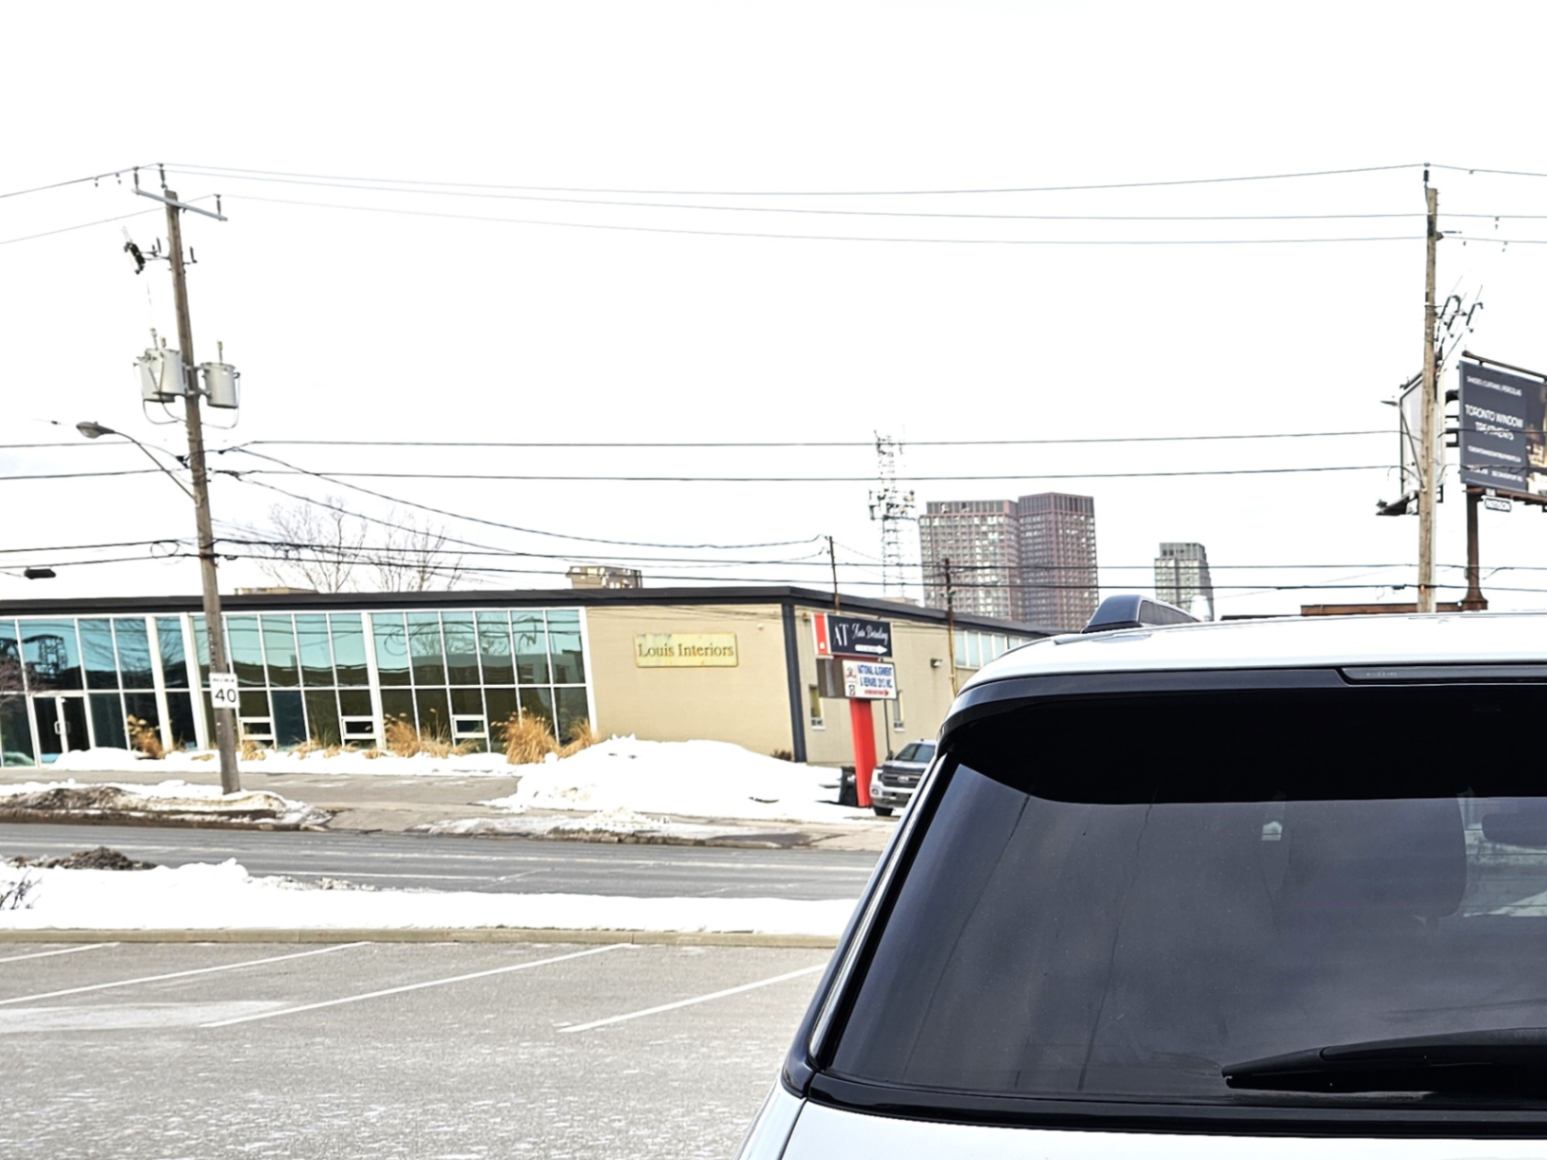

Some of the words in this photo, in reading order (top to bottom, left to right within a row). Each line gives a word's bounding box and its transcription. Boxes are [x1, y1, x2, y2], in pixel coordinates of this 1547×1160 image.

[1465, 404, 1495, 421] TORONTO
[1496, 413, 1523, 428] WINDOW
[833, 623, 849, 647] AT
[638, 643, 674, 657] Louis
[678, 642, 734, 657] Interiors
[215, 688, 237, 703] 40
